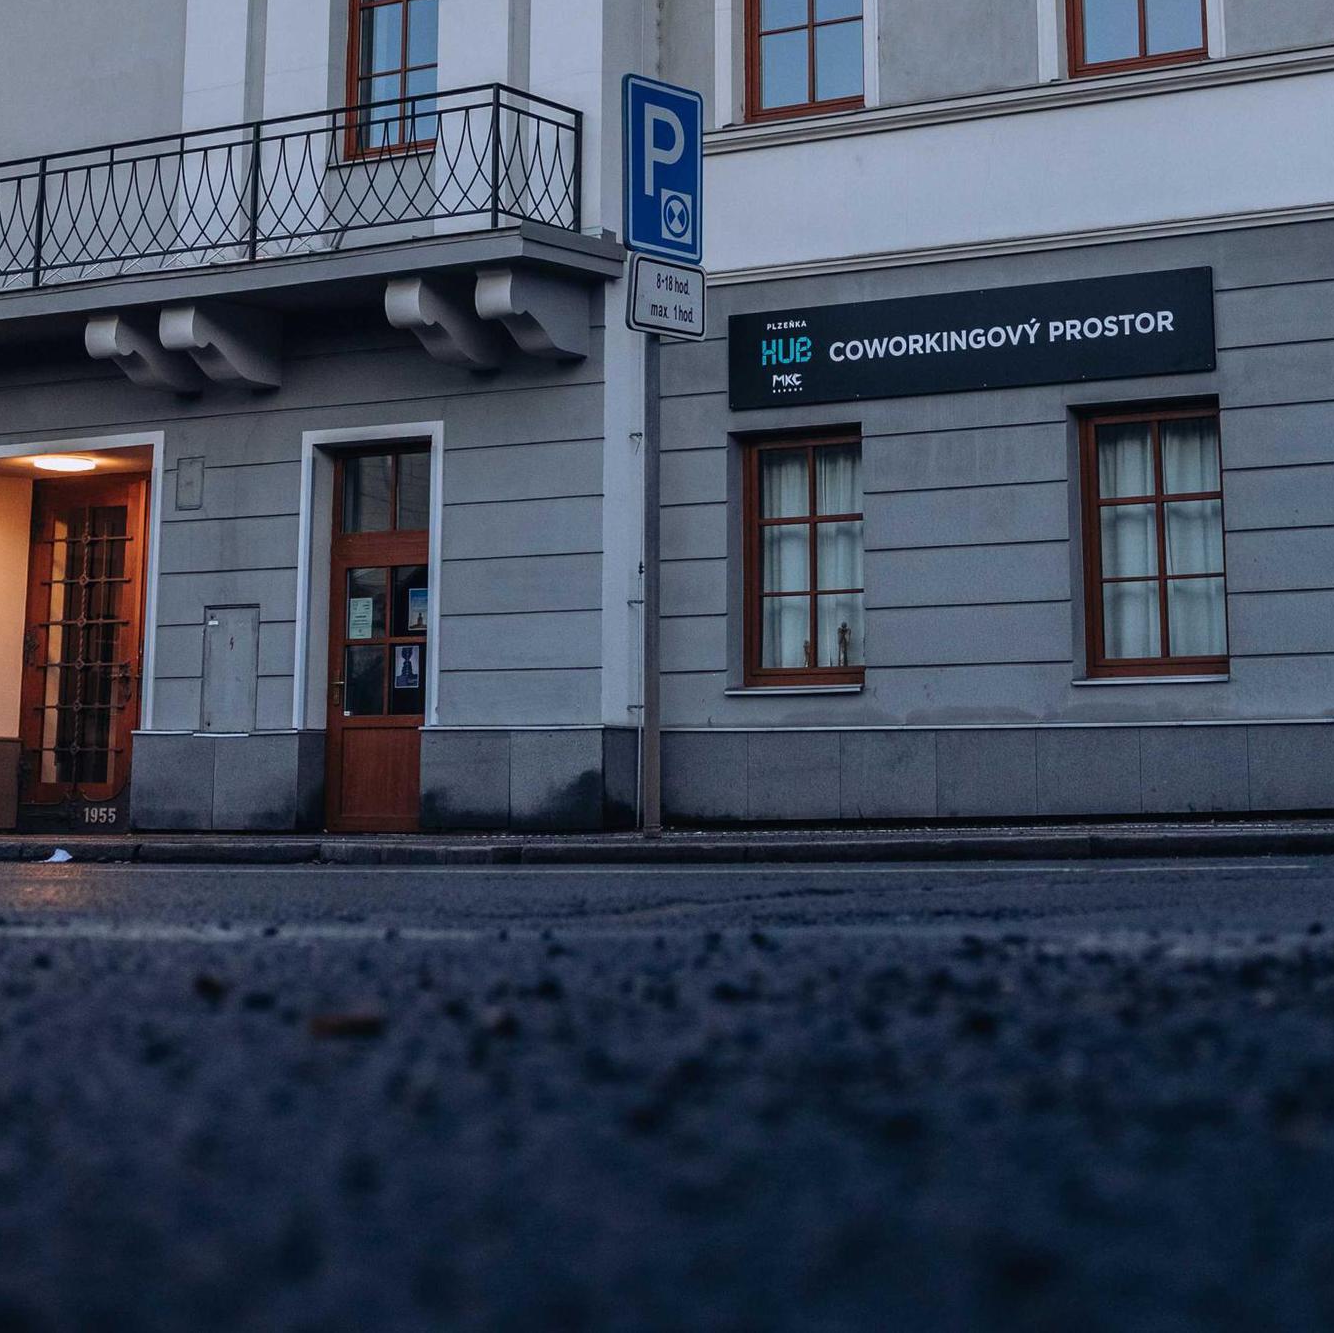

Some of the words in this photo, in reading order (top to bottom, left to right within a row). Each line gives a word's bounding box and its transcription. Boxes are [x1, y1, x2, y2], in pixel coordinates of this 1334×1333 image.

[643, 101, 685, 196] P
[656, 272, 673, 292] 8-18
[674, 277, 690, 295] hod.
[650, 303, 670, 319] max.
[673, 304, 678, 320] 1
[678, 305, 695, 324] hod.
[766, 320, 807, 331] PLZEŇKA
[828, 318, 1041, 362] COWORKINGOVÝ
[1048, 310, 1175, 343] PROSTOR
[762, 336, 812, 366] HUB
[772, 373, 803, 387] MKC
[83, 807, 116, 823] 1955
